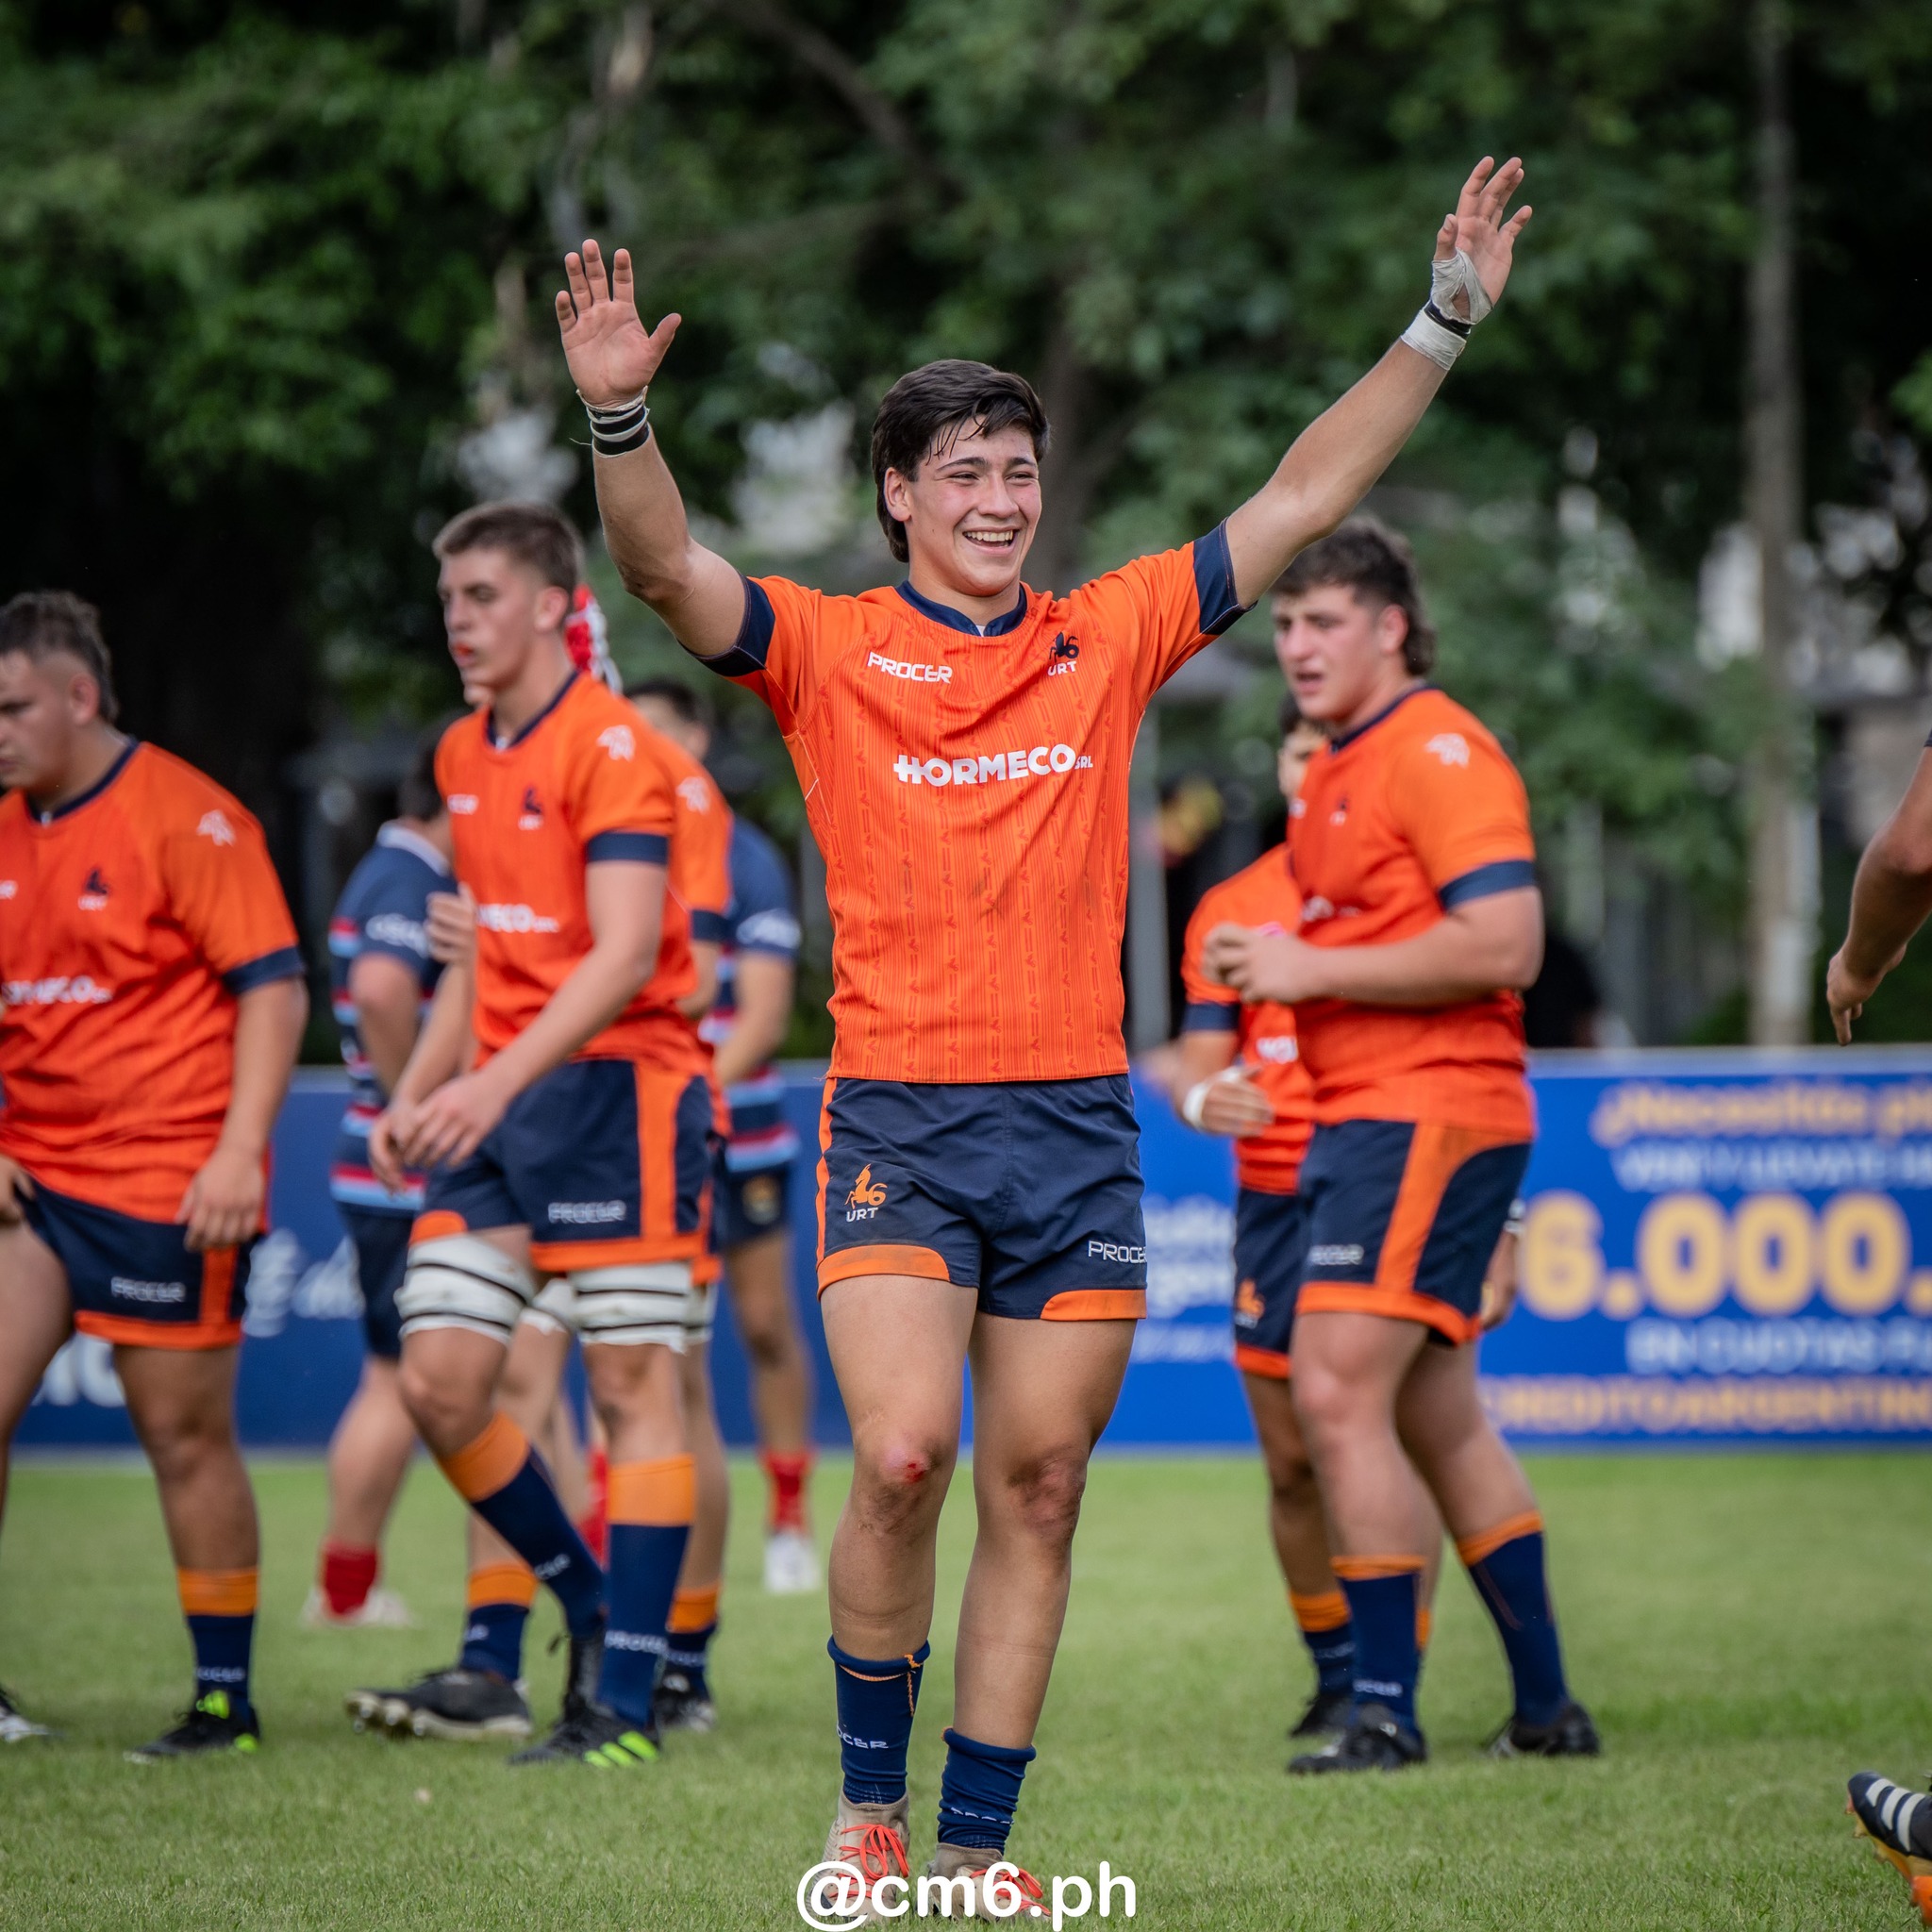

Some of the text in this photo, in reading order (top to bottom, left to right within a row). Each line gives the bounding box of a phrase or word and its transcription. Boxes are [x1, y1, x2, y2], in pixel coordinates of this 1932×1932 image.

[868, 651, 953, 684] PROCER
[1047, 660, 1077, 676] URT
[893, 743, 1076, 787] HORMECO
[846, 1208, 878, 1223] URT
[1088, 1241, 1147, 1264] PROCE
